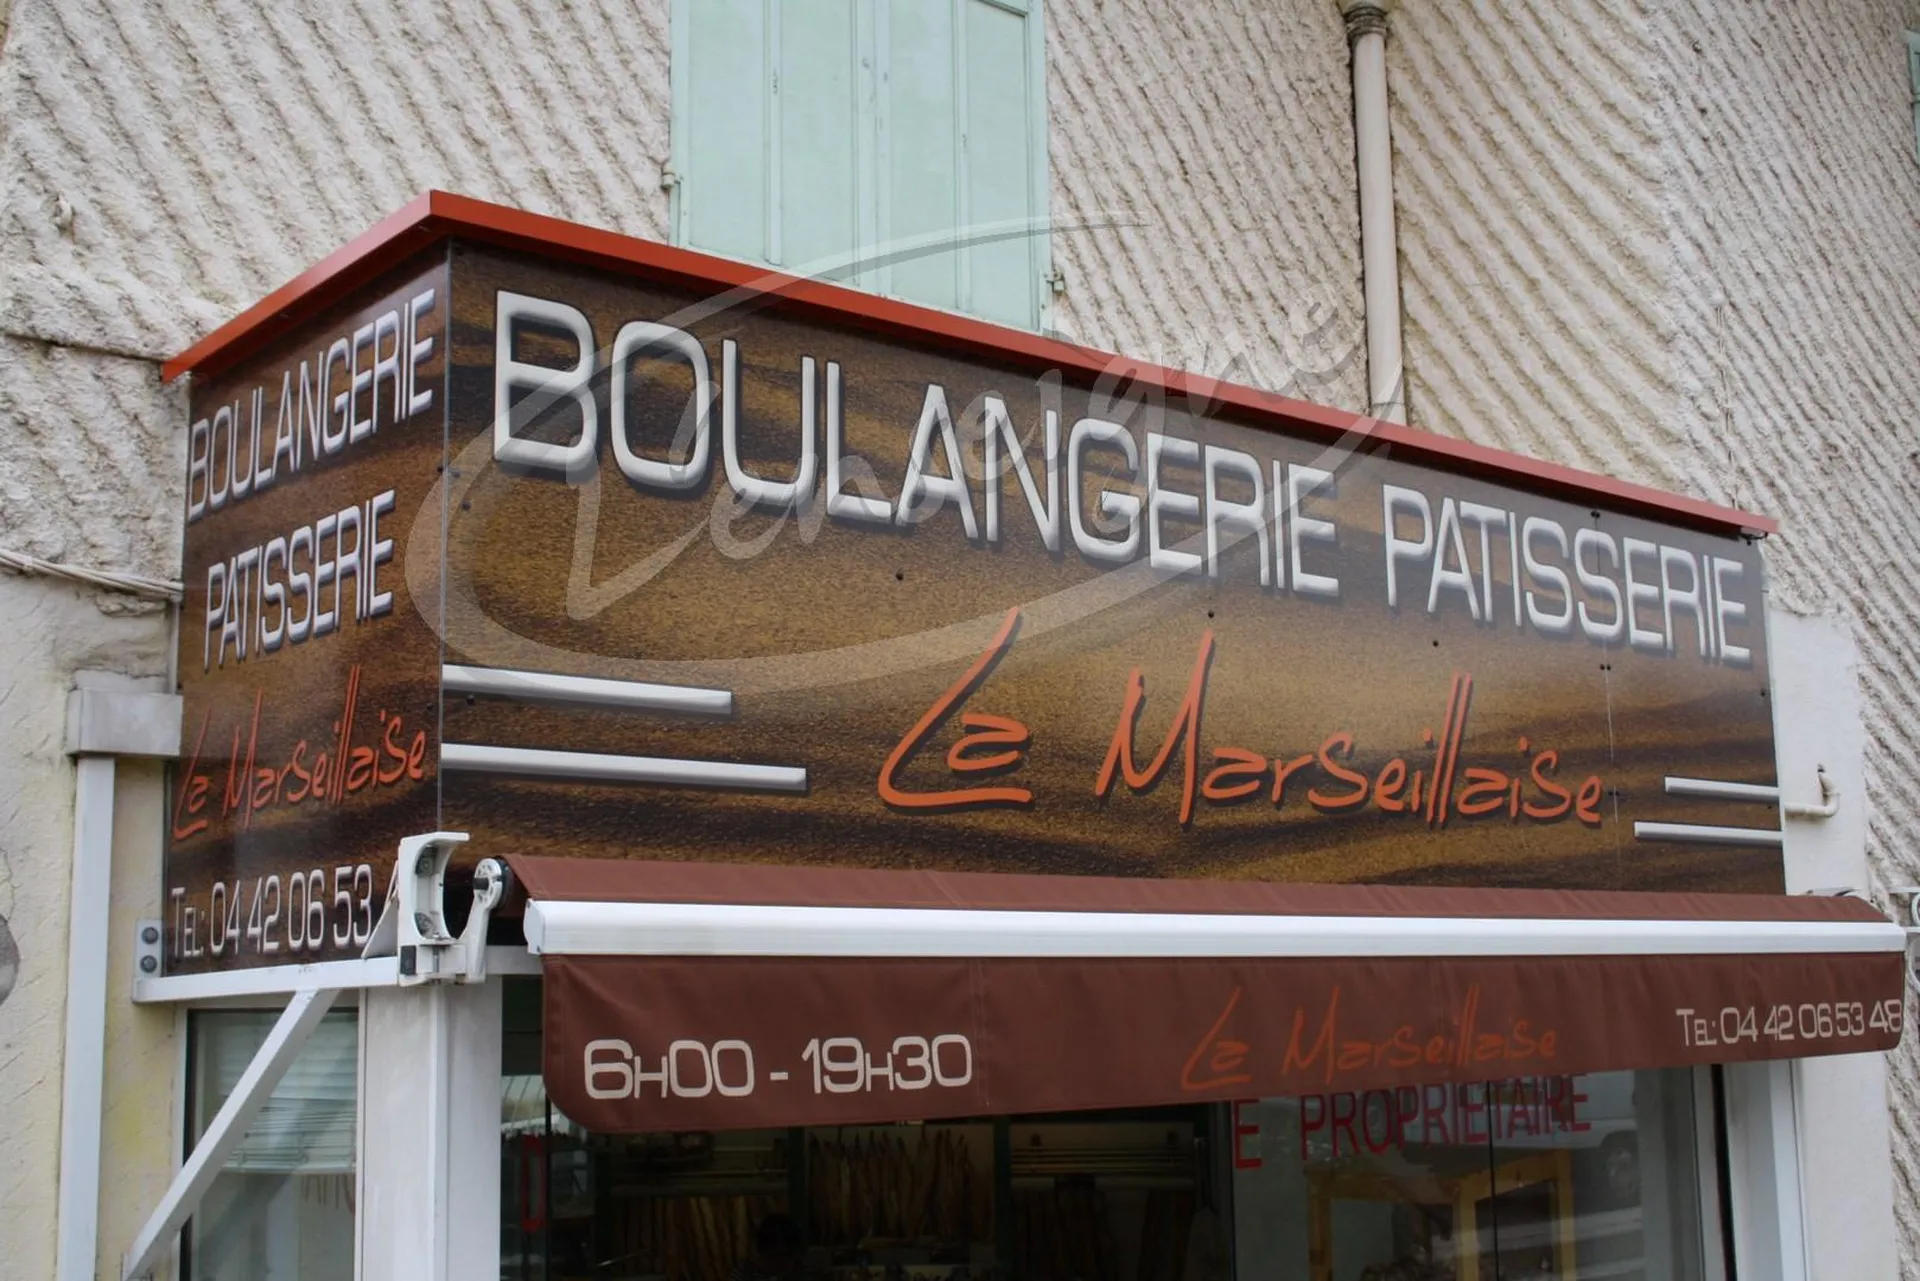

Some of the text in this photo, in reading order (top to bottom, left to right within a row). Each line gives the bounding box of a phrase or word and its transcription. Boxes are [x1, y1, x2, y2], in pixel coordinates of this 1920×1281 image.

[188, 288, 435, 524] BOULANGERIE
[494, 290, 1751, 662] BOULANGERIE PATISSERIE
[204, 489, 396, 673] PATISSERIE
[173, 664, 427, 841] La Marseillaise
[877, 605, 1602, 825] La Marseillaise
[210, 880, 241, 954] 04
[247, 875, 281, 953] 42
[288, 869, 325, 950] 06
[333, 864, 372, 948] 53
[1180, 986, 1251, 1091] La
[1720, 1006, 1758, 1043] 04
[1764, 1004, 1795, 1041] 42
[1869, 999, 1902, 1034] 48
